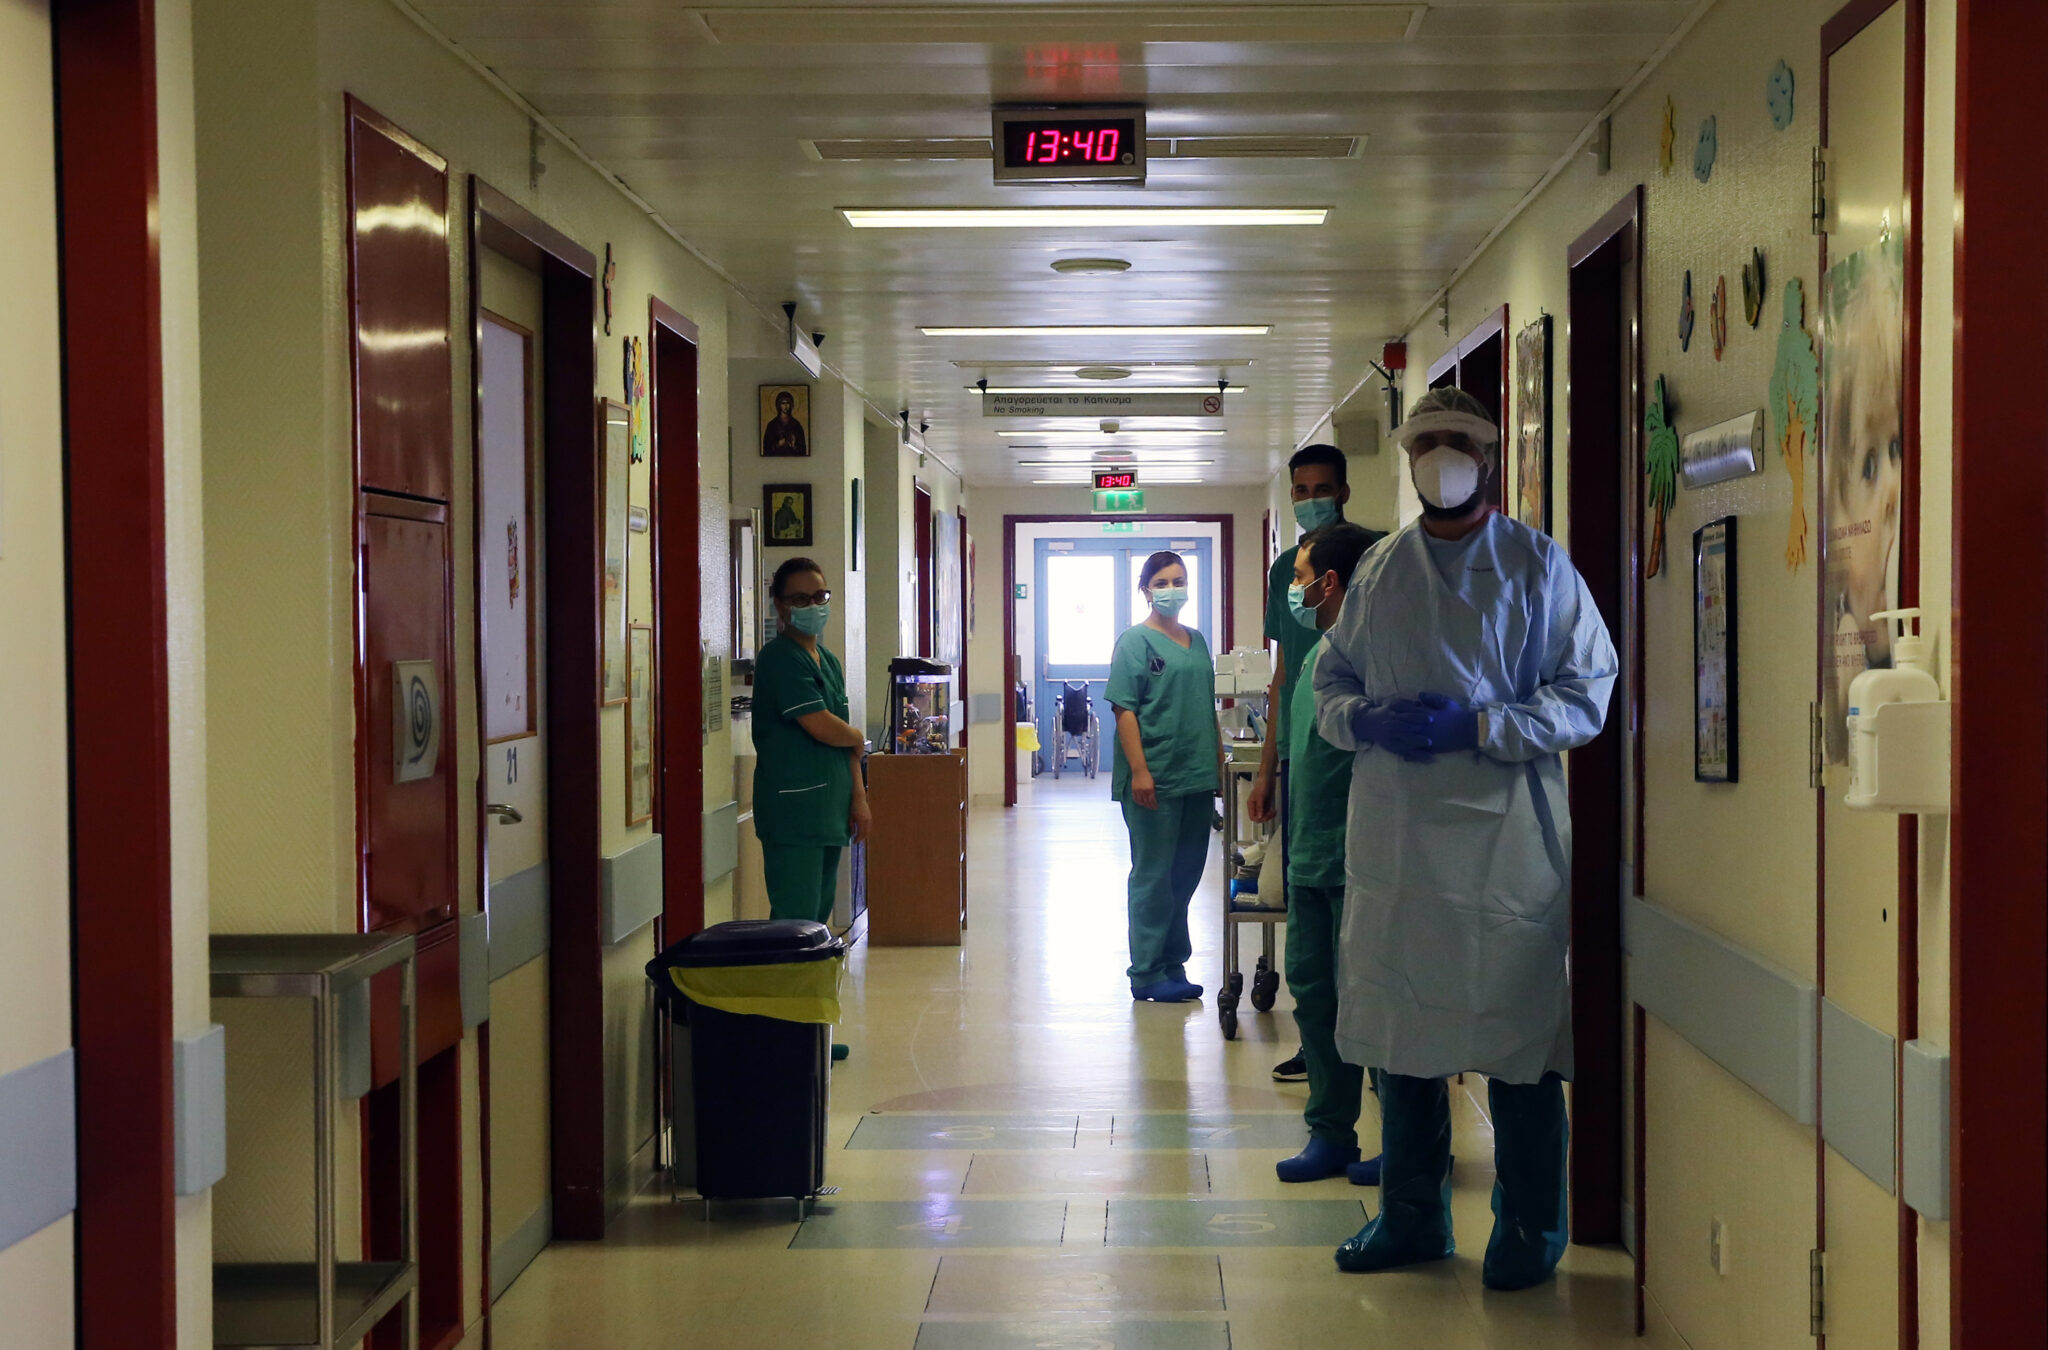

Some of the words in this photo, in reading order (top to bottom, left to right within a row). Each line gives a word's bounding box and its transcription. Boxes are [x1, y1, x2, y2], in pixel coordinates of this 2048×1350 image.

[1025, 129, 1120, 163] 13:40
[993, 406, 1006, 414] No
[1009, 406, 1045, 415] Smoking
[1100, 474, 1131, 487] 13:40
[506, 746, 517, 785] 21
[1204, 1212, 1277, 1234] 5
